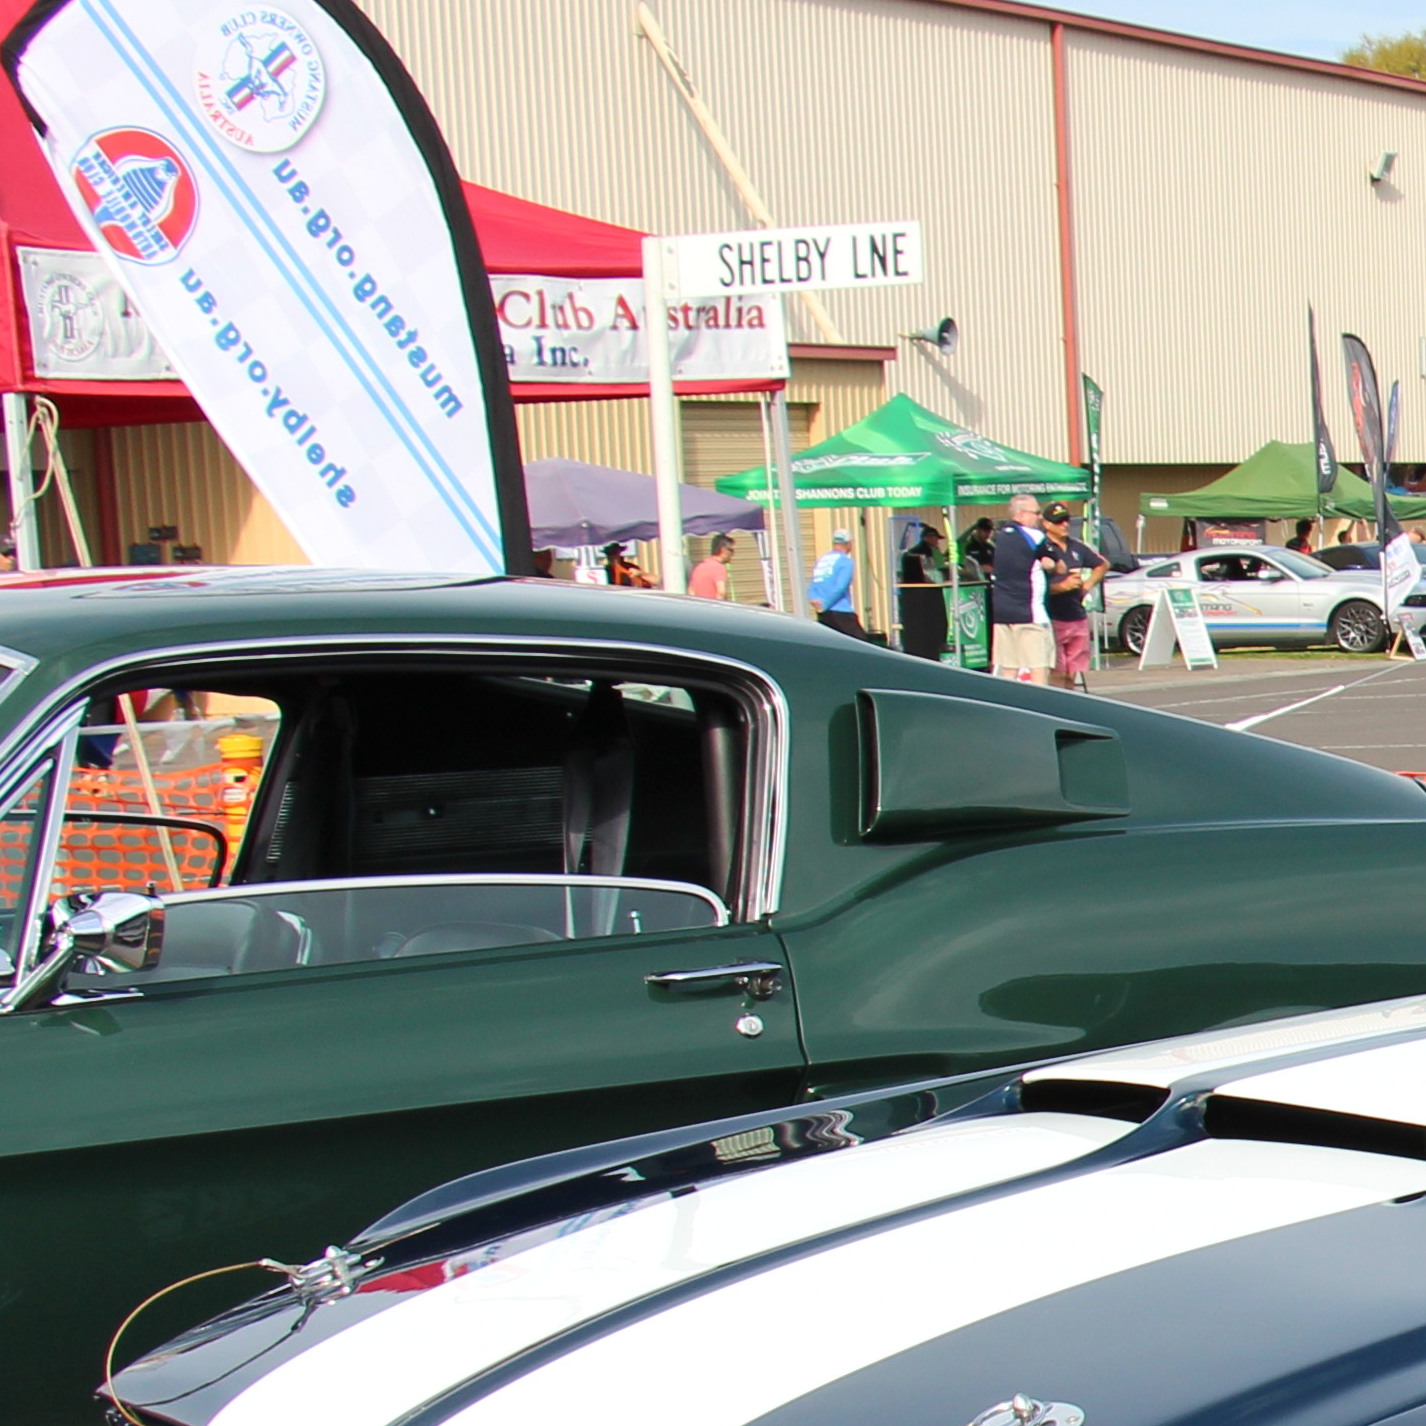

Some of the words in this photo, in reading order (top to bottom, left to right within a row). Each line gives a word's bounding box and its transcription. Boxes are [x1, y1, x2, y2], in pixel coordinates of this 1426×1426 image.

[718, 237, 831, 288] SHELBY
[852, 232, 909, 279] LNE
[498, 289, 595, 331] Club
[610, 293, 766, 331] Astralia
[532, 335, 589, 367] Inc.
[795, 487, 855, 500] SHANNONS
[856, 486, 886, 499] CLUB
[887, 486, 923, 498] TODAY
[997, 483, 1011, 495] FOR
